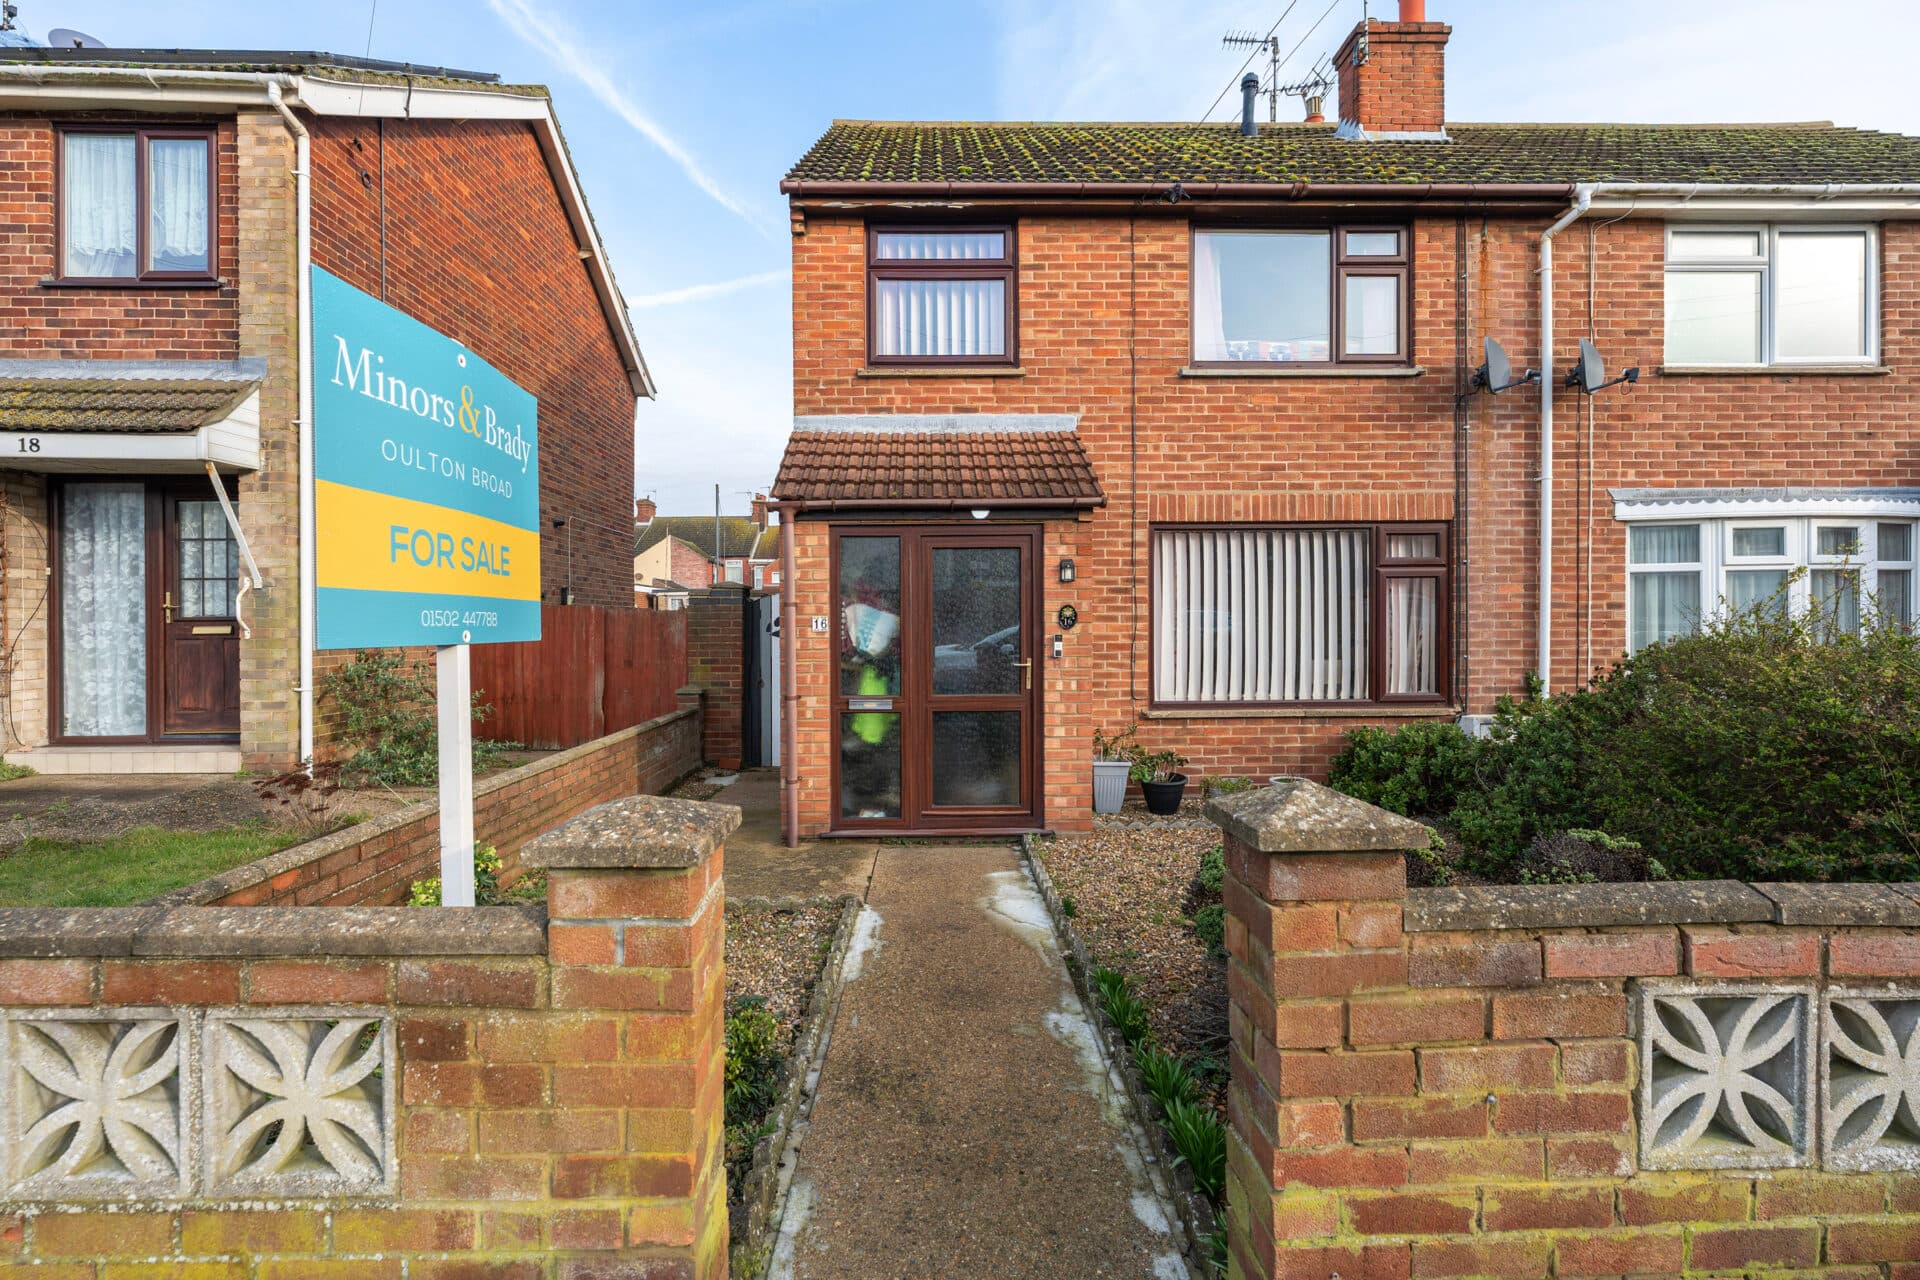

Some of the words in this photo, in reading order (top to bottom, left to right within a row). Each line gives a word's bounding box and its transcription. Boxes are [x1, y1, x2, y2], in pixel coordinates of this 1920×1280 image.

[331, 334, 455, 428] Minors
[458, 385, 482, 438] &
[483, 405, 532, 473] Brady
[18, 437, 40, 453] 18
[381, 439, 465, 481] OULTON
[472, 466, 513, 499] BROAD
[390, 525, 455, 570] FOR
[461, 536, 511, 577] SALE
[421, 609, 460, 627] 01502
[462, 611, 498, 627] 447788
[814, 618, 827, 629] 16
